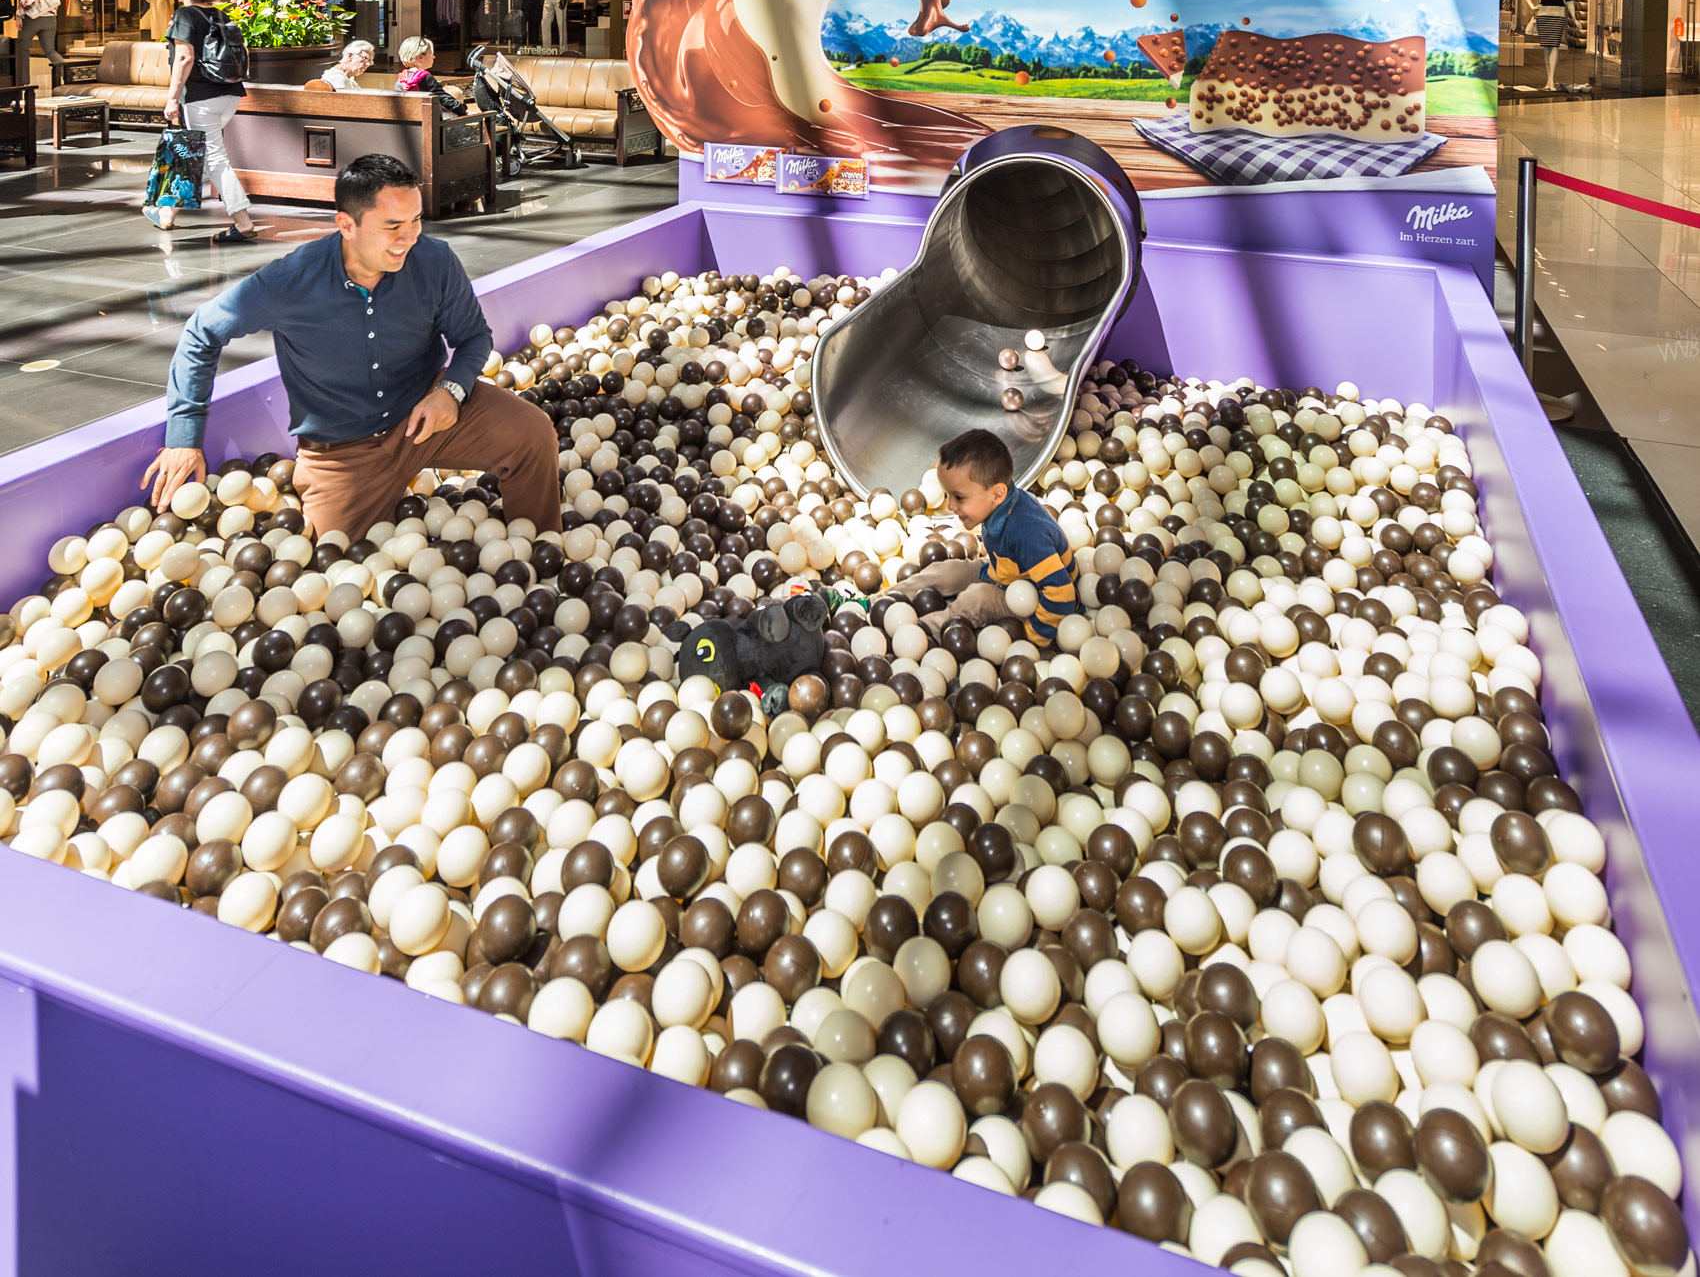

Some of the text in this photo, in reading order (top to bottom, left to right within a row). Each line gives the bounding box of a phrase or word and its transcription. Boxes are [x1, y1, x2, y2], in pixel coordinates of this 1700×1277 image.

[518, 45, 558, 56] strellson
[713, 147, 746, 164] Milka
[785, 158, 820, 175] Milka
[1405, 202, 1474, 231] Milka
[1399, 231, 1478, 247] Im Herzen zart.
